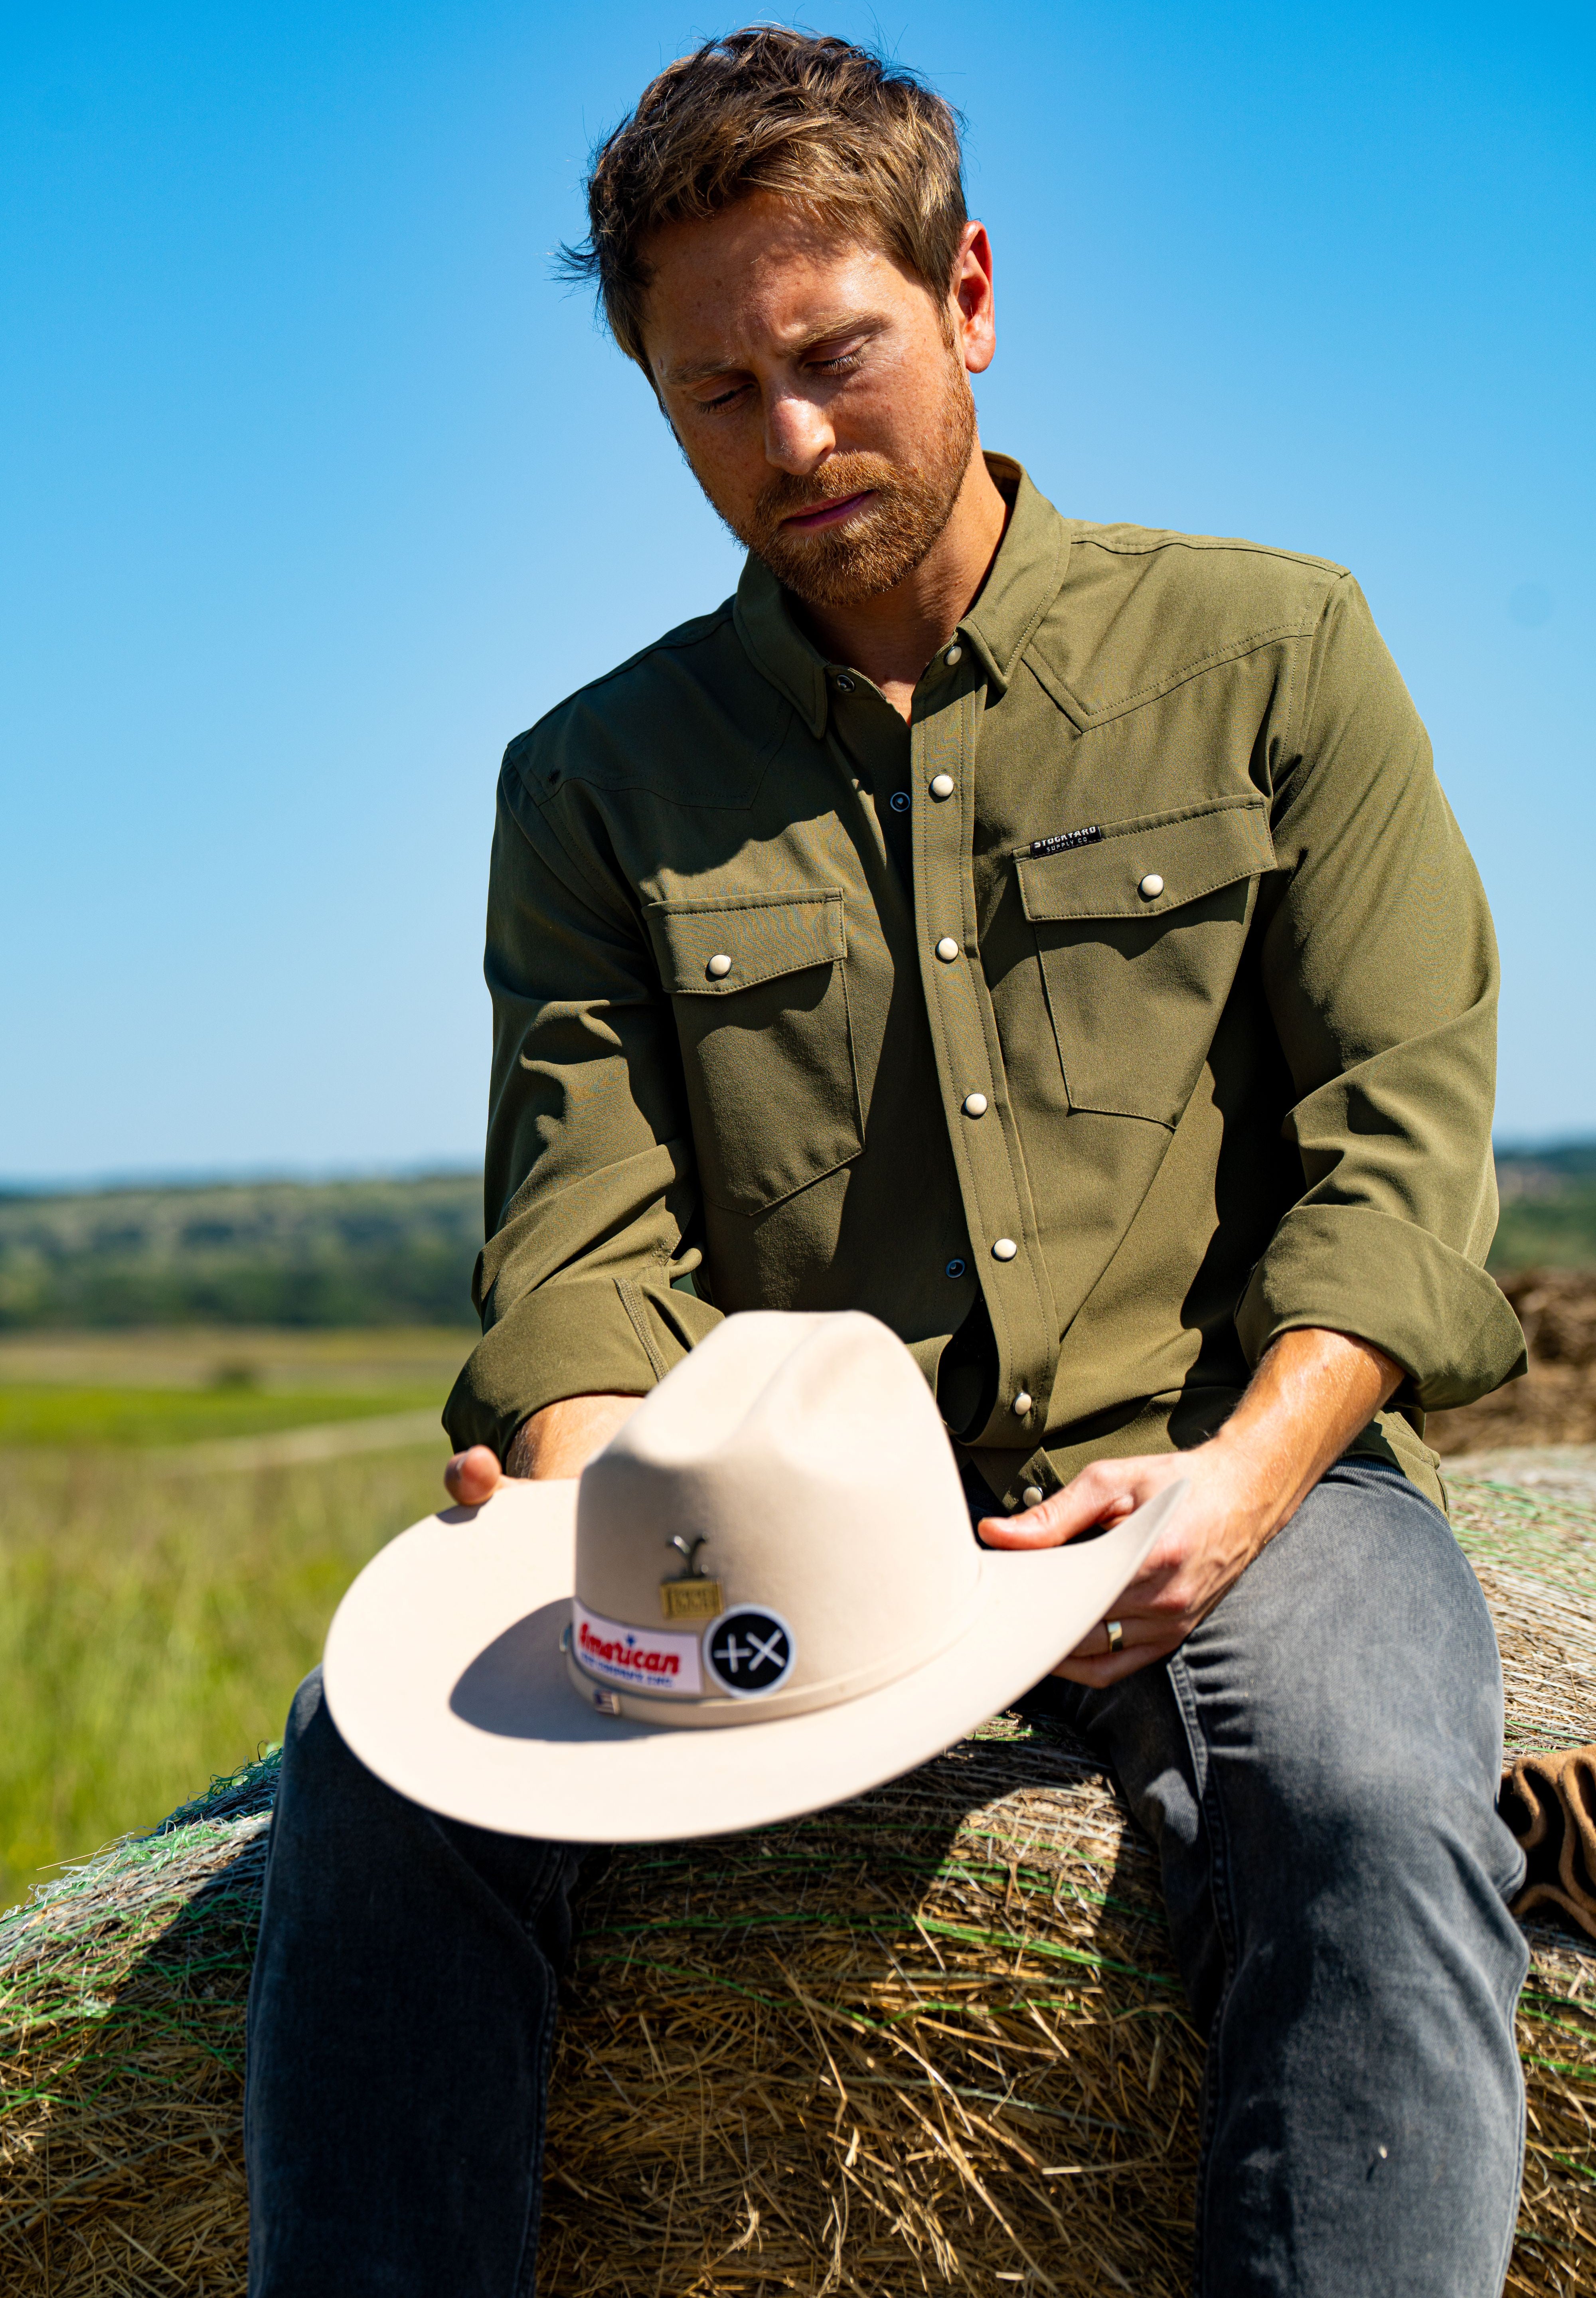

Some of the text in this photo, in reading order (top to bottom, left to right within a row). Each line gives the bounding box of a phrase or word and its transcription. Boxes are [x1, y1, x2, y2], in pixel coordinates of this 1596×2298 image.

[1034, 826, 1096, 849] STOCKYARD
[1046, 840, 1074, 852] SUPPLY
[580, 1623, 680, 1675] American
